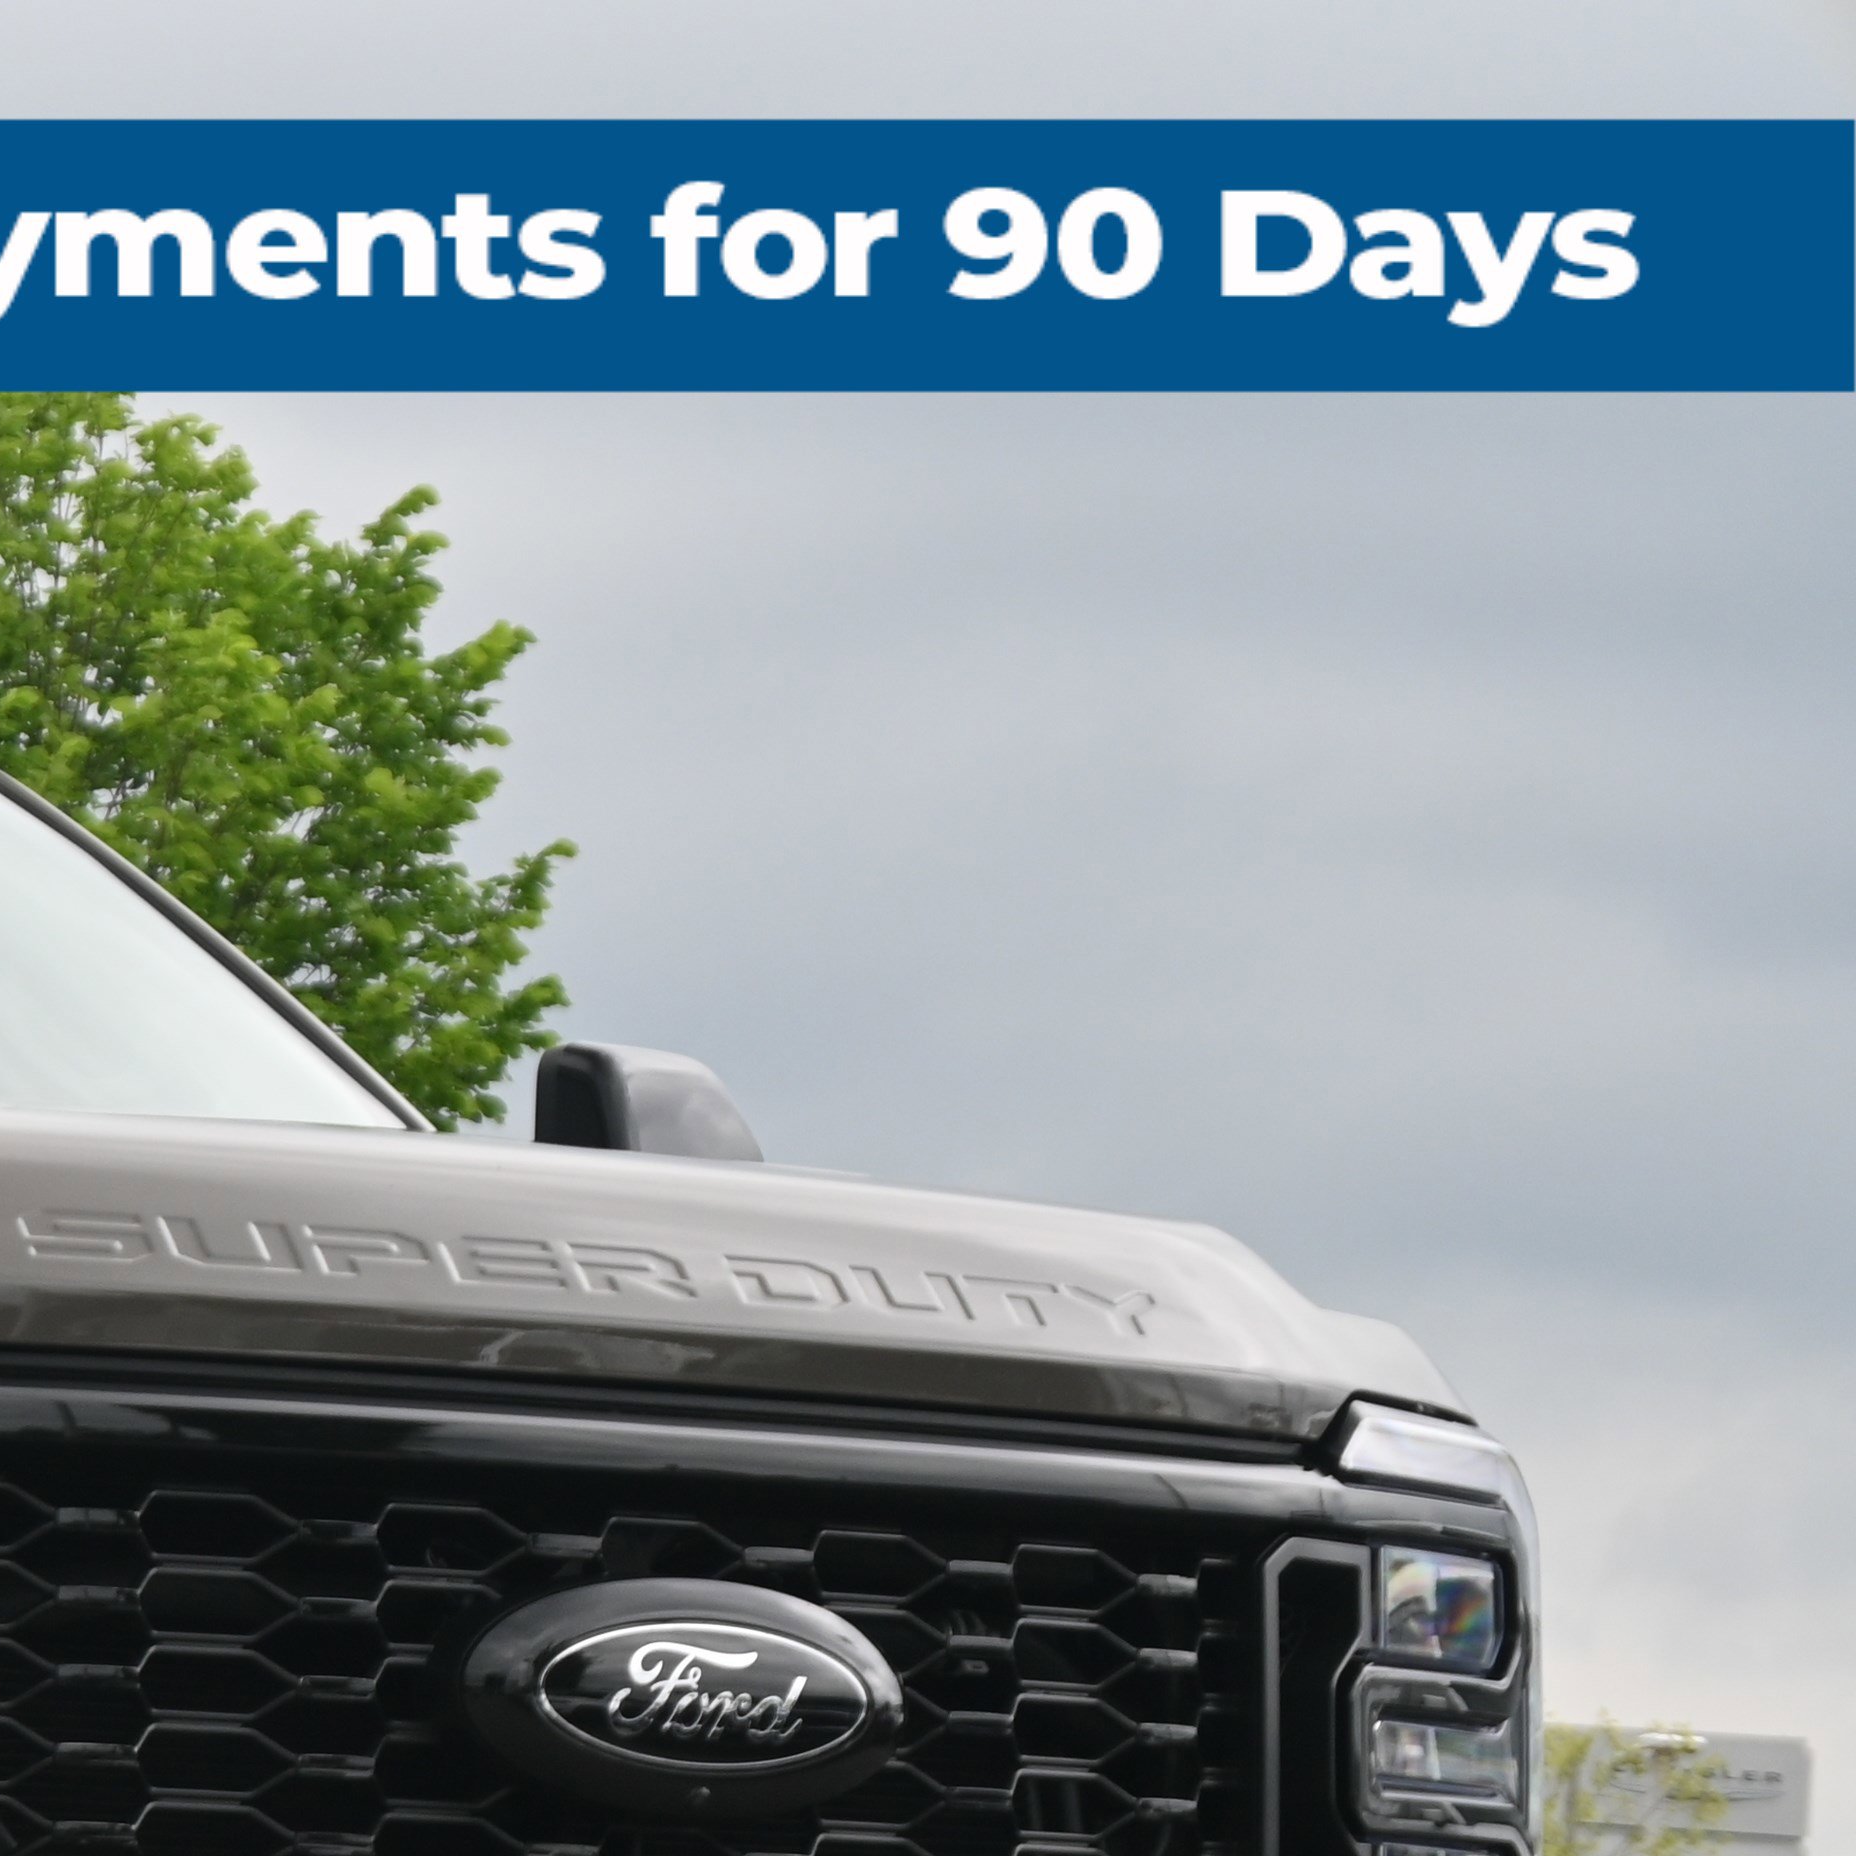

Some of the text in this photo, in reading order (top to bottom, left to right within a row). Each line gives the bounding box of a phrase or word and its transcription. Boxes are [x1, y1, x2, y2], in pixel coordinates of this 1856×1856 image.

[16, 1211, 1157, 1337] SUPER DUTY
[607, 1640, 808, 1742] Ford
